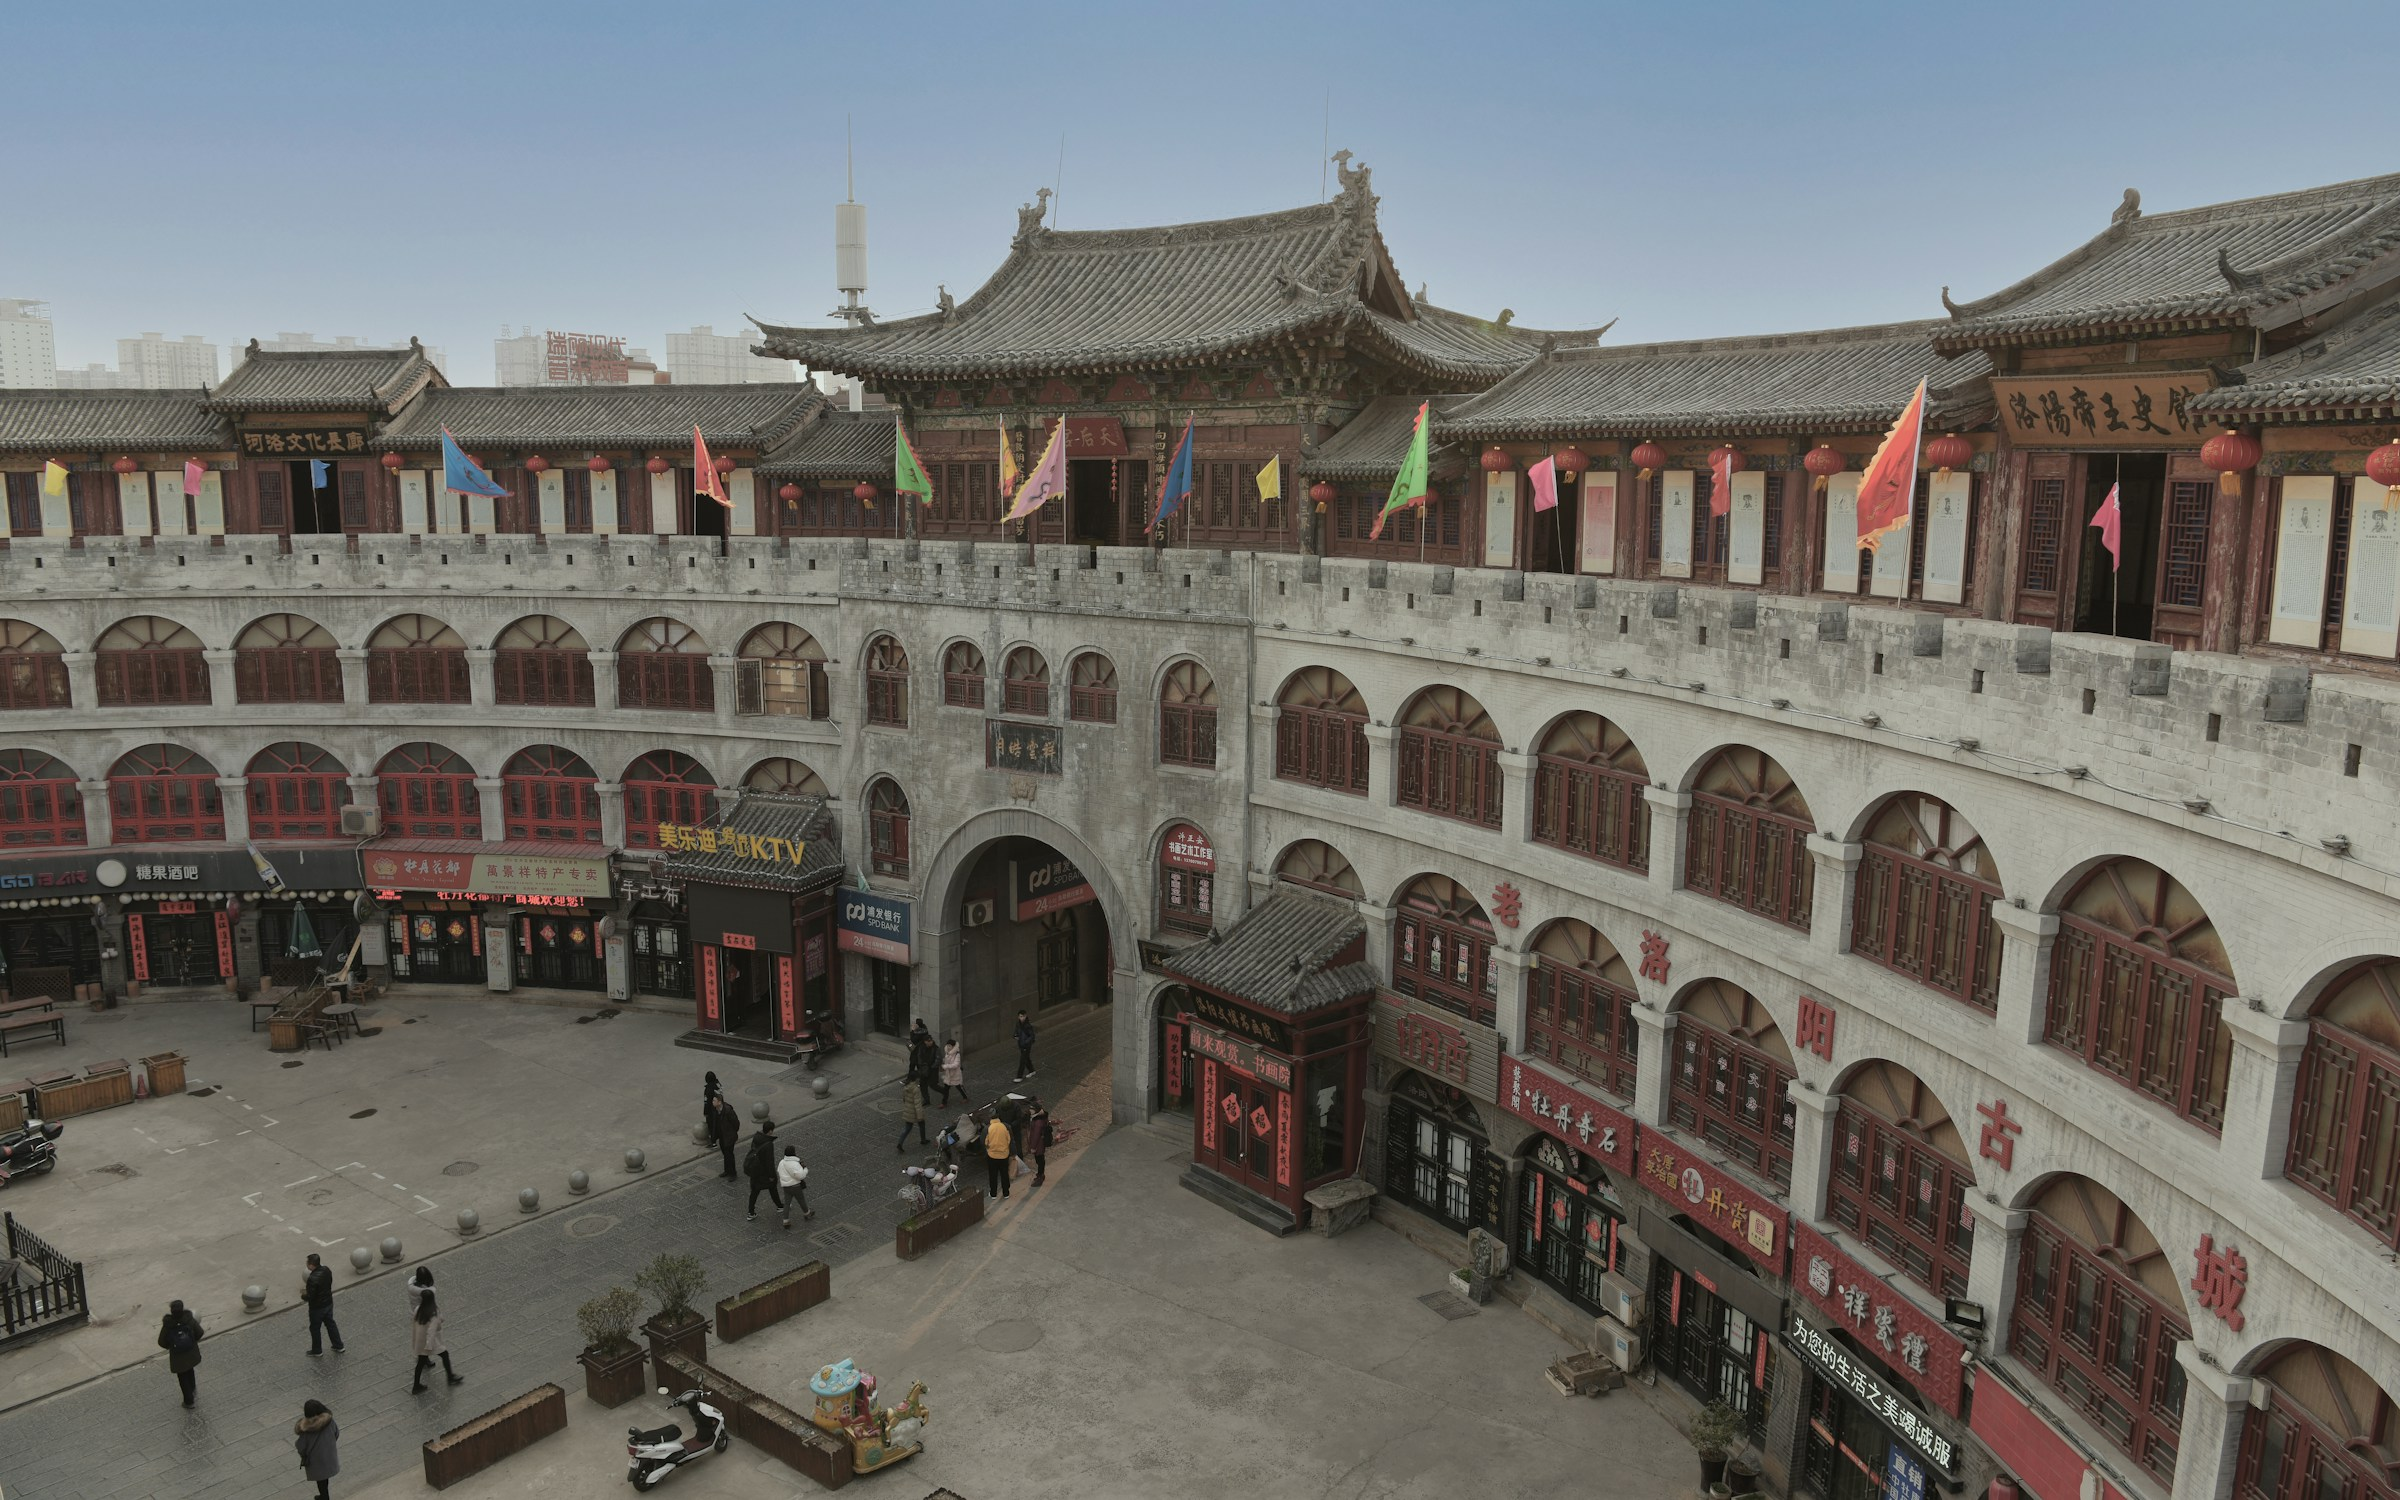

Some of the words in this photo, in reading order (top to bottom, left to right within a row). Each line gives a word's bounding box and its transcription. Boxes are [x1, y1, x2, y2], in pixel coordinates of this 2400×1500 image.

[1169, 842, 1213, 860] 书画艺术工作室
[136, 864, 199, 881] 糖果酒吧
[404, 858, 461, 877] 牡丹花都
[1054, 875, 1068, 886] SPD
[621, 880, 680, 907] 手工布
[866, 906, 901, 923] 浦发银行
[1035, 898, 1048, 913] 24
[868, 918, 880, 928] SPD
[881, 922, 899, 932] BANK
[853, 936, 864, 947] 24
[1252, 1054, 1291, 1086] 书画院
[1226, 1100, 1237, 1118] 福
[1255, 1112, 1266, 1129] 福
[1532, 1089, 1616, 1154] 牡丹奇石
[1787, 1341, 1802, 1359] Xiang
[1793, 1317, 1952, 1468] 为您的生活之美竭诚服
[1892, 1453, 1923, 1491] 直销
